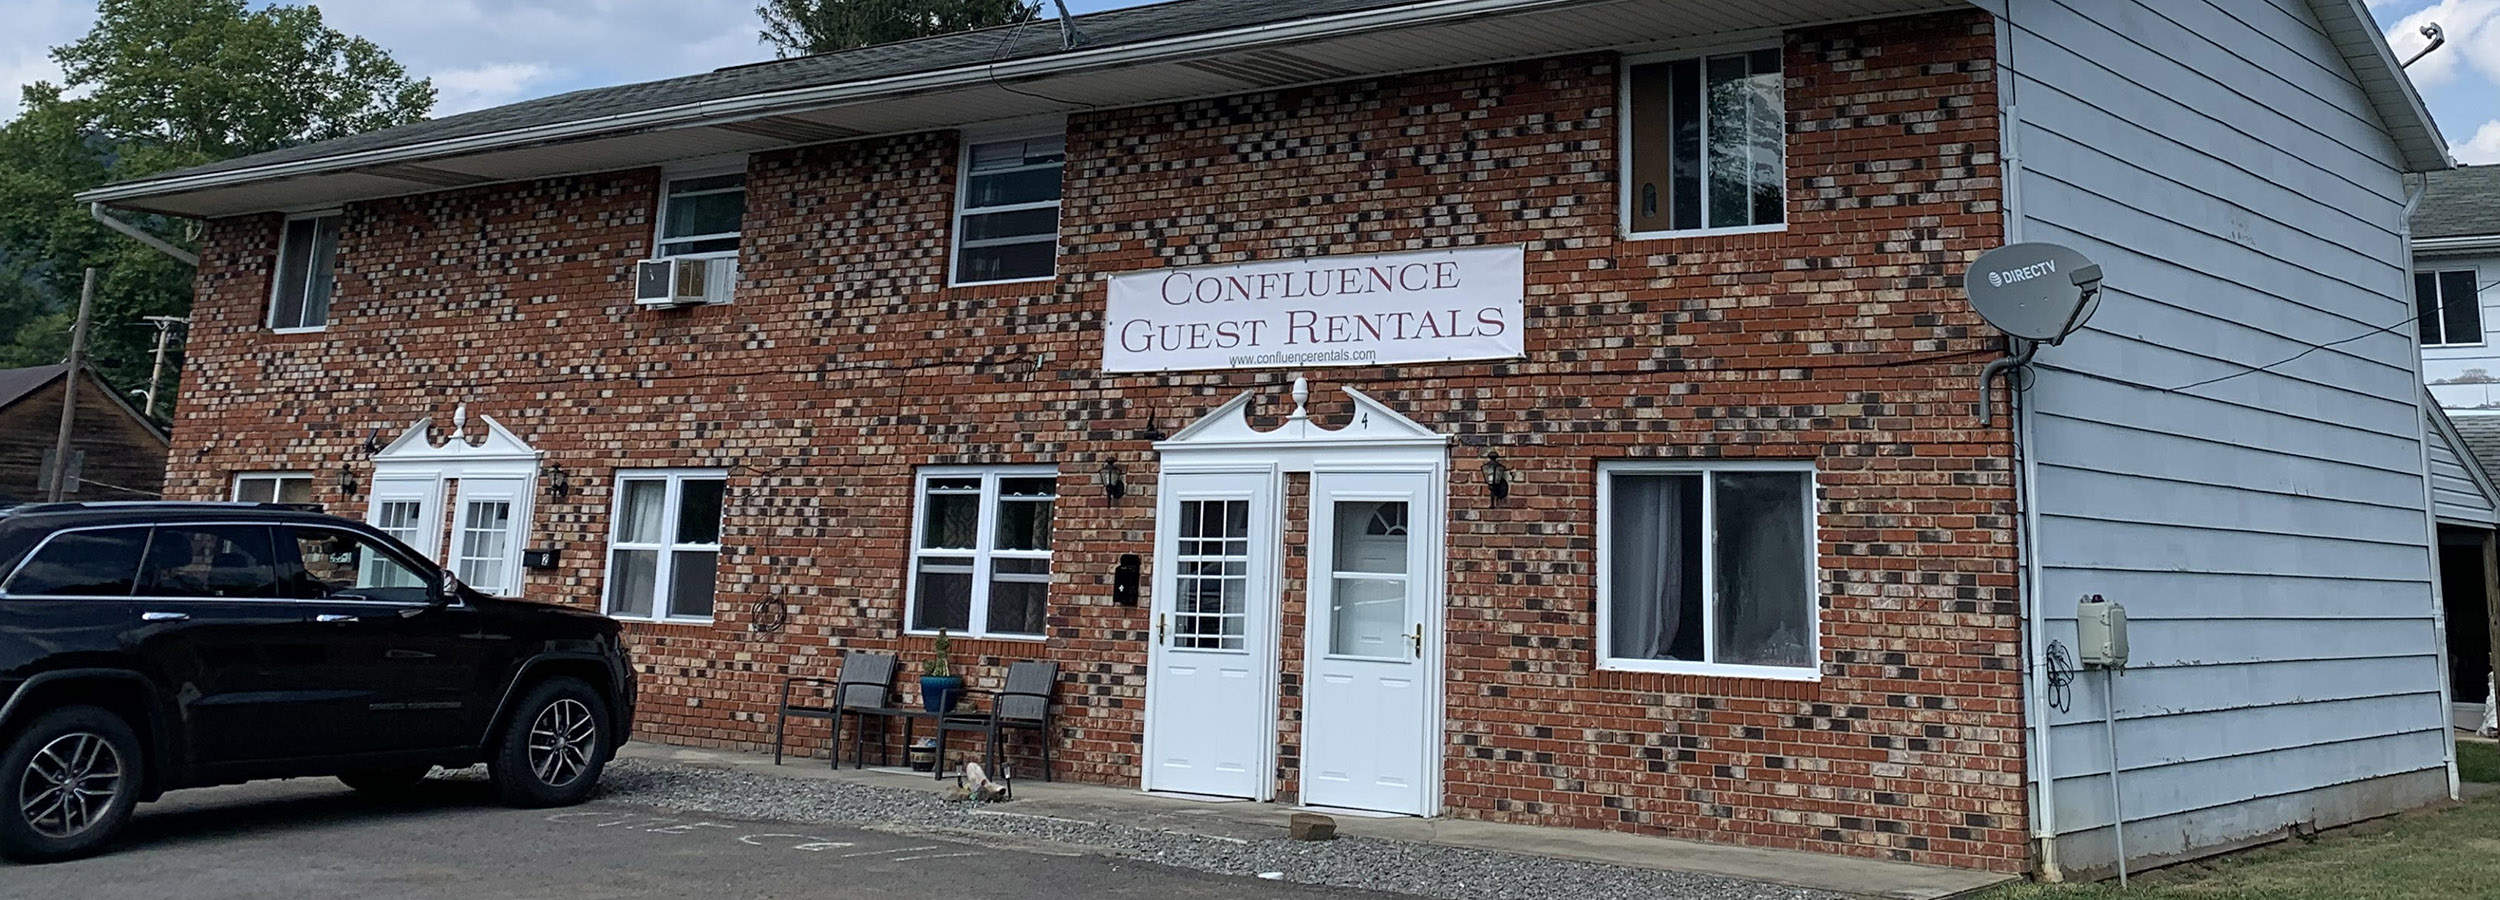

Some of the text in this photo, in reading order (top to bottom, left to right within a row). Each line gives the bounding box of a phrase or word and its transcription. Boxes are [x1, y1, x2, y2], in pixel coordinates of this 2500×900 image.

[1161, 261, 1461, 305] CONFLUENCE
[2002, 260, 2056, 284] DIRECTV
[1121, 307, 1505, 353] GUEST RENTALS
[1229, 348, 1376, 366] www.confluencerentals.com
[1361, 412, 1368, 430] 4
